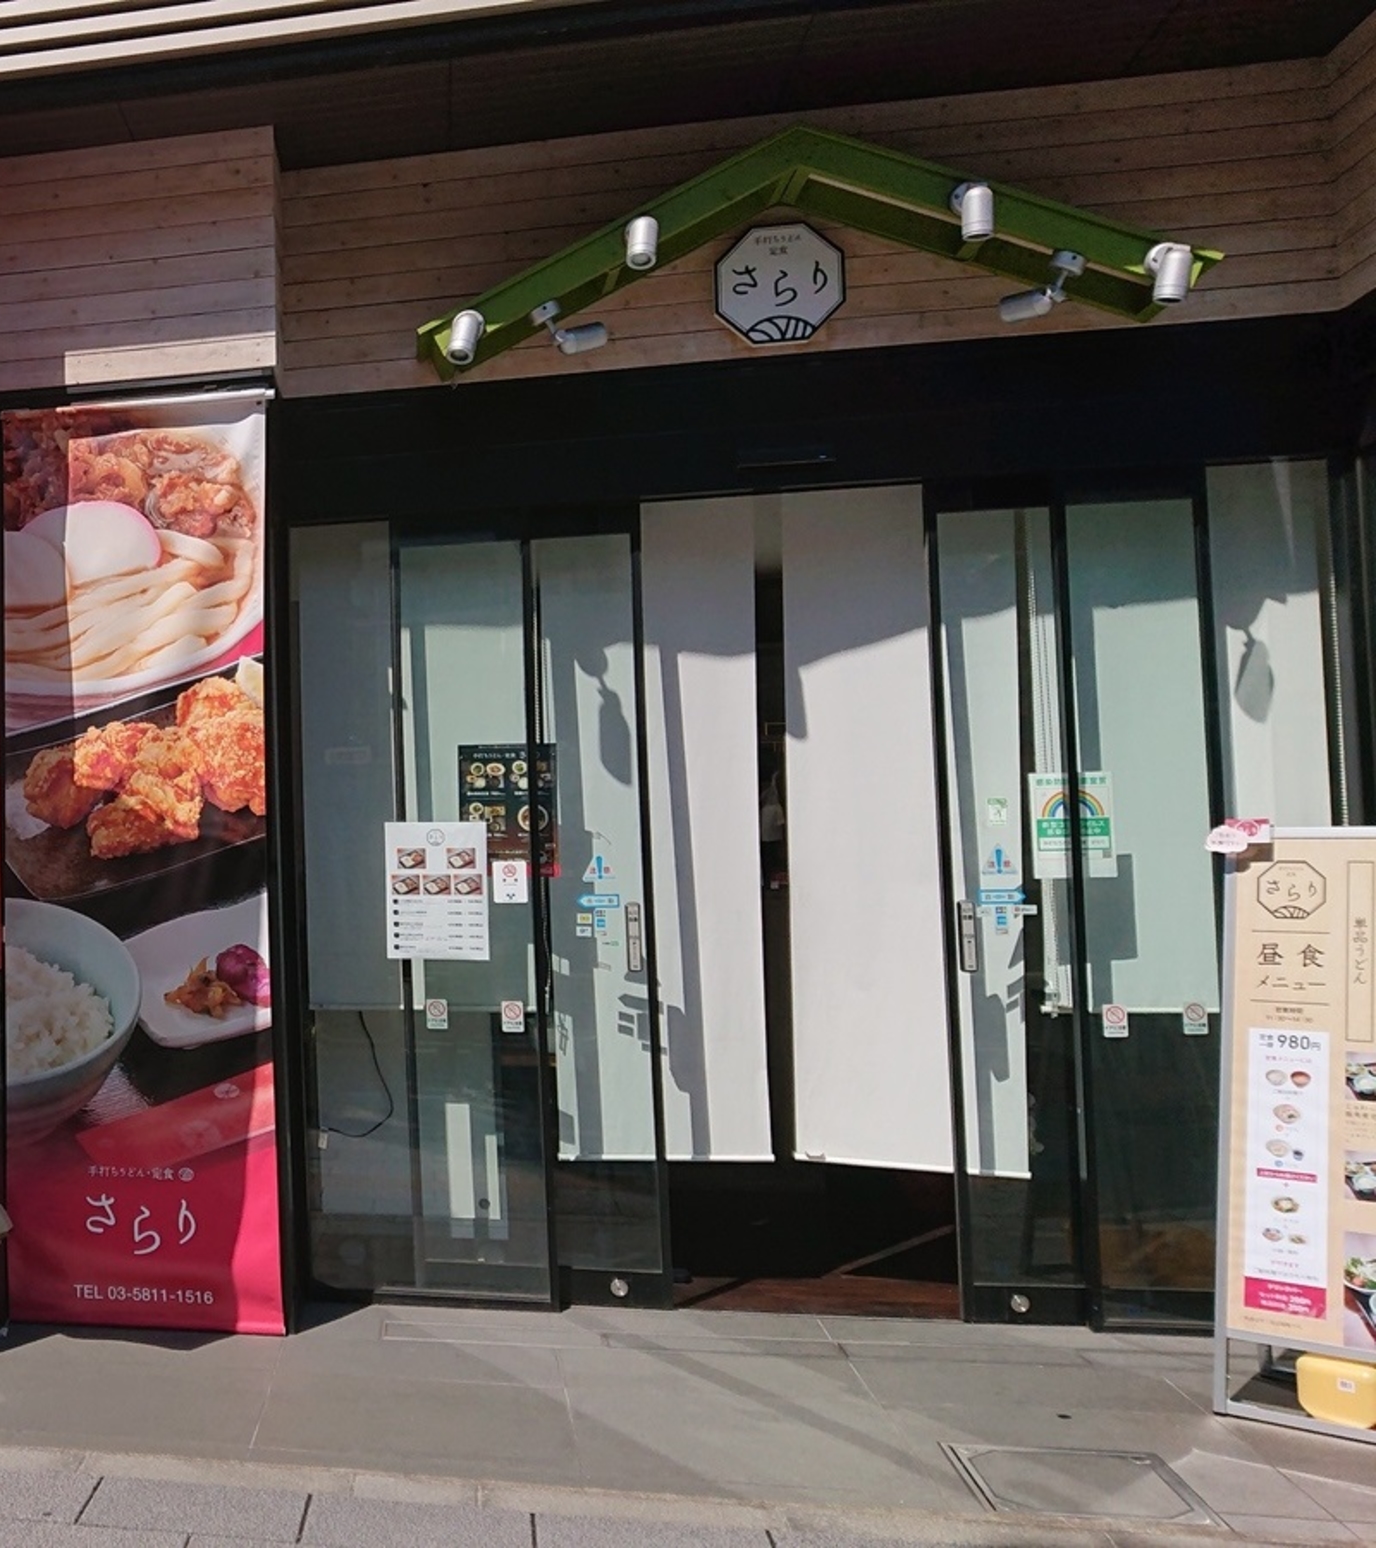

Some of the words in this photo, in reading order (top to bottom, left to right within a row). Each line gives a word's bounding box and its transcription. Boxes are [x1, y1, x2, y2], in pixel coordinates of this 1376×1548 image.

[731, 260, 828, 307] さらり
[1265, 879, 1318, 902] さらり
[1257, 942, 1326, 968] 昼食
[1352, 916, 1369, 985] 単品うどん
[1257, 974, 1327, 991] メニュー
[85, 1193, 197, 1255] さらり
[74, 1284, 104, 1299] TEL
[108, 1286, 214, 1304] 03-5811-1516
